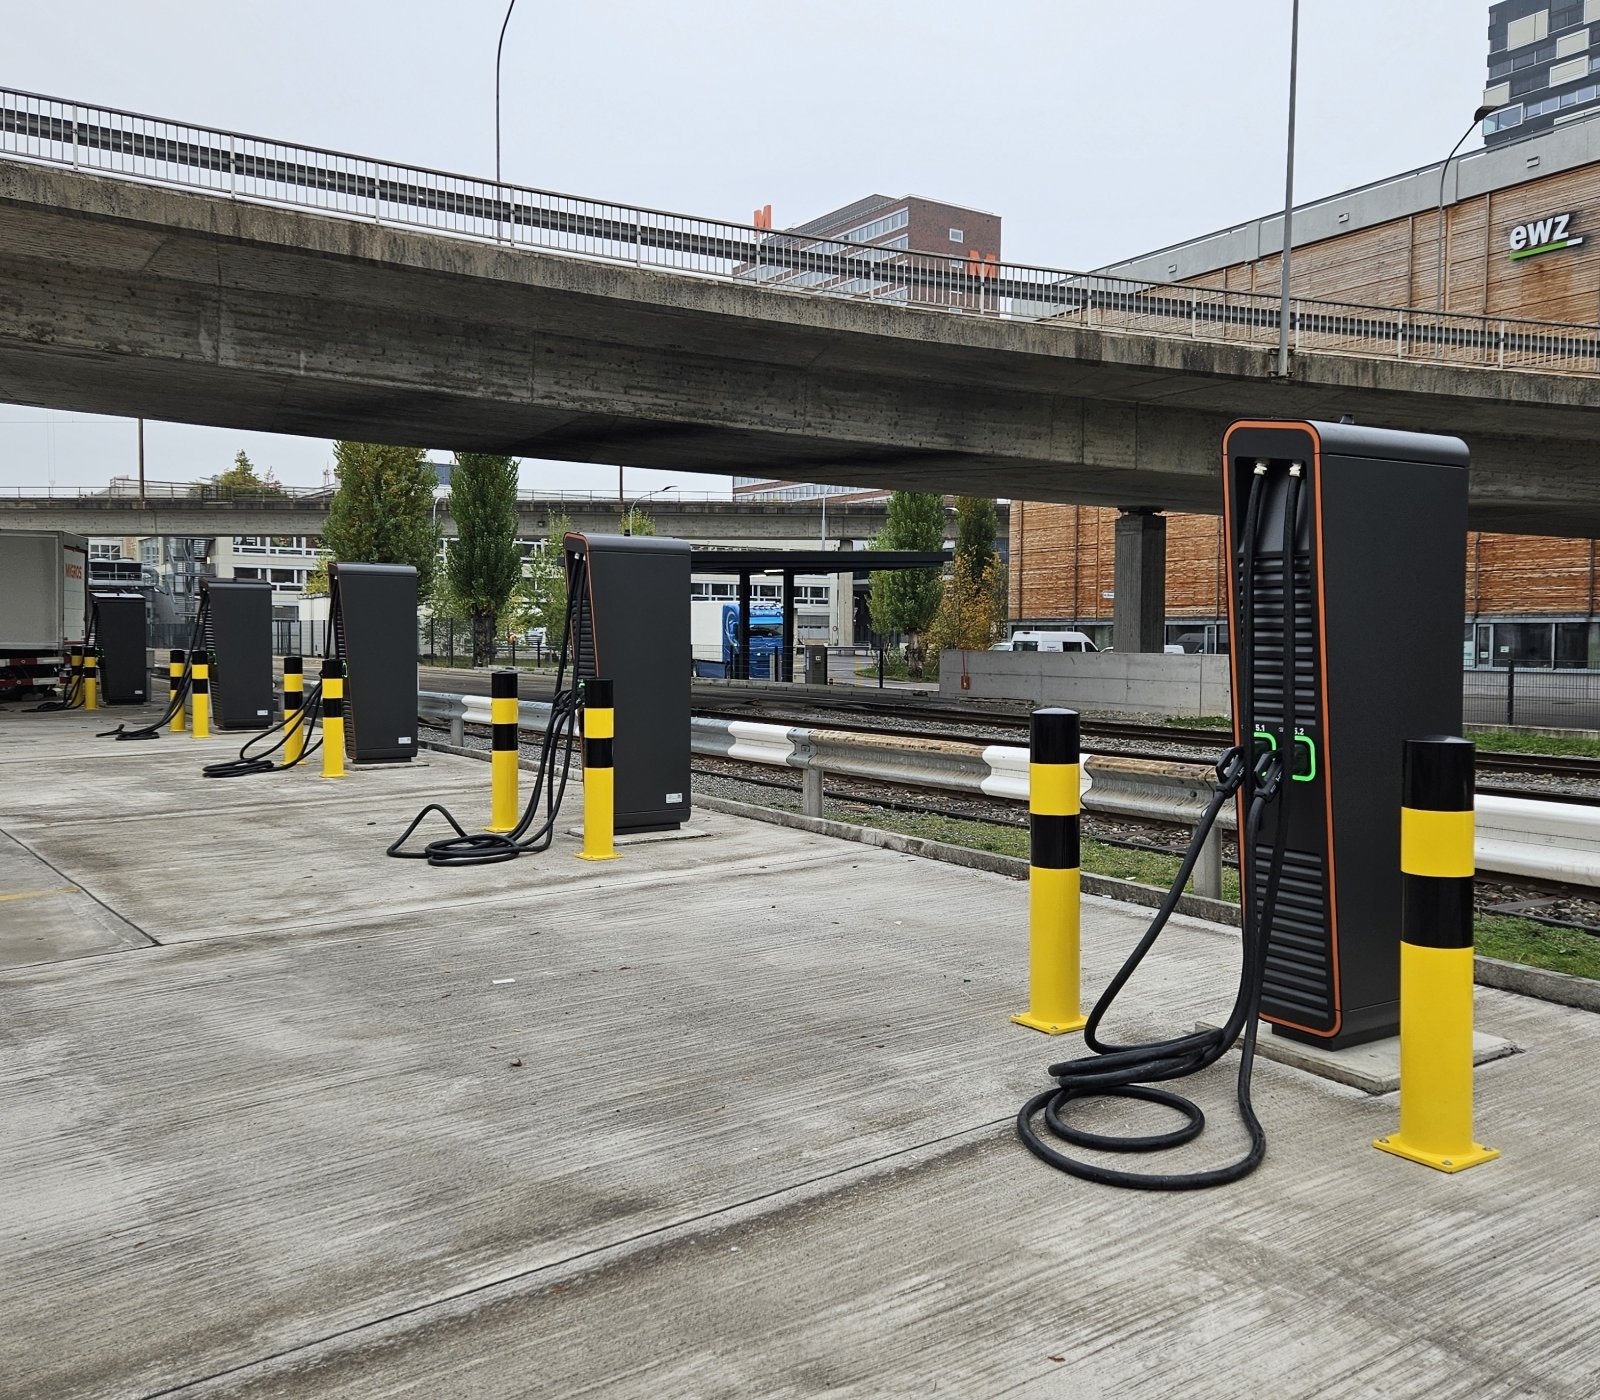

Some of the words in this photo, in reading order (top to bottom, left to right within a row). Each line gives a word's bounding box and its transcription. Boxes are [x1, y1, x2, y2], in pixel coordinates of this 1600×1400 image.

[1510, 213, 1570, 250] ewz
[65, 563, 82, 579] MIGROS
[1255, 723, 1265, 732] 5.1
